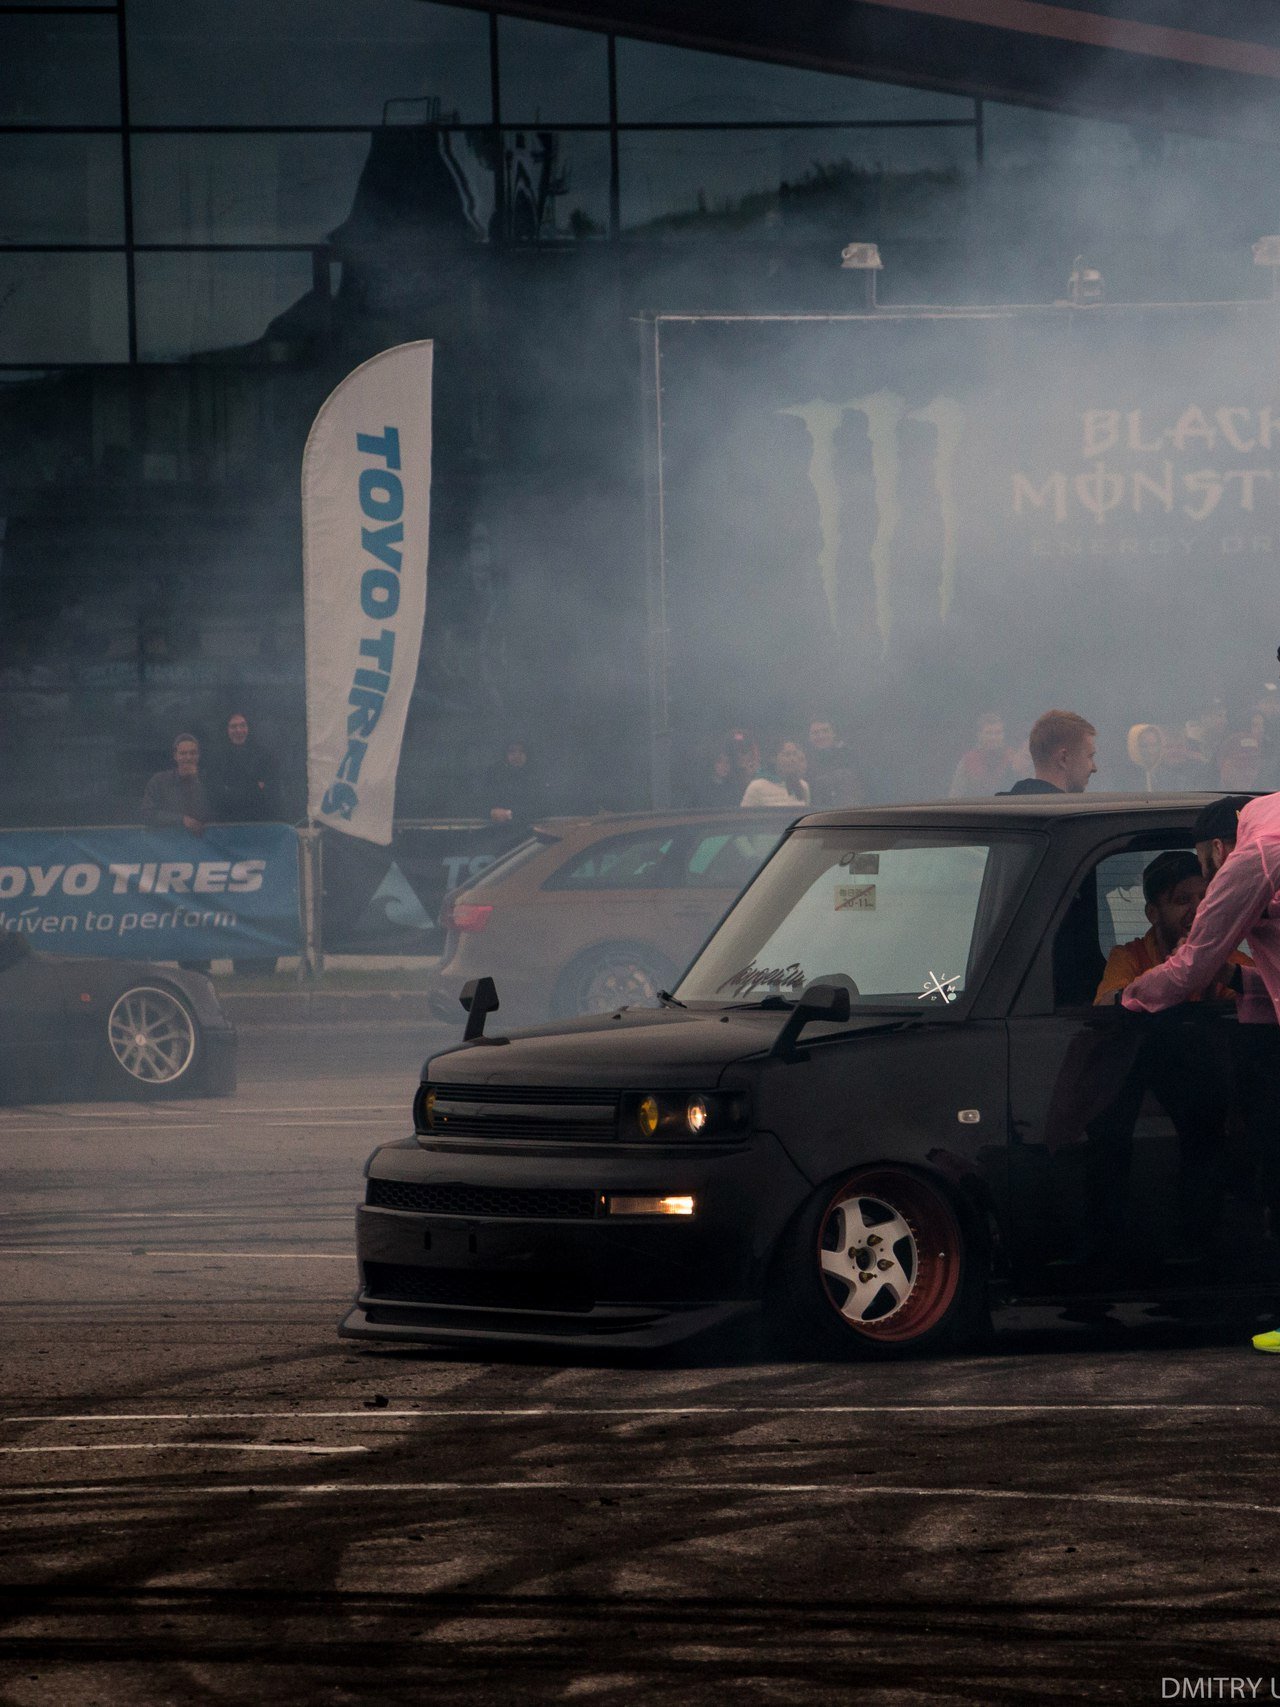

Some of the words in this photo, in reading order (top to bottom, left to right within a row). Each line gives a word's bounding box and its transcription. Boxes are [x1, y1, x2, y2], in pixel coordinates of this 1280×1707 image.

[356, 426, 404, 620] TOYO
[109, 859, 266, 894] TIRES
[85, 911, 114, 932] to
[119, 906, 237, 937] perform
